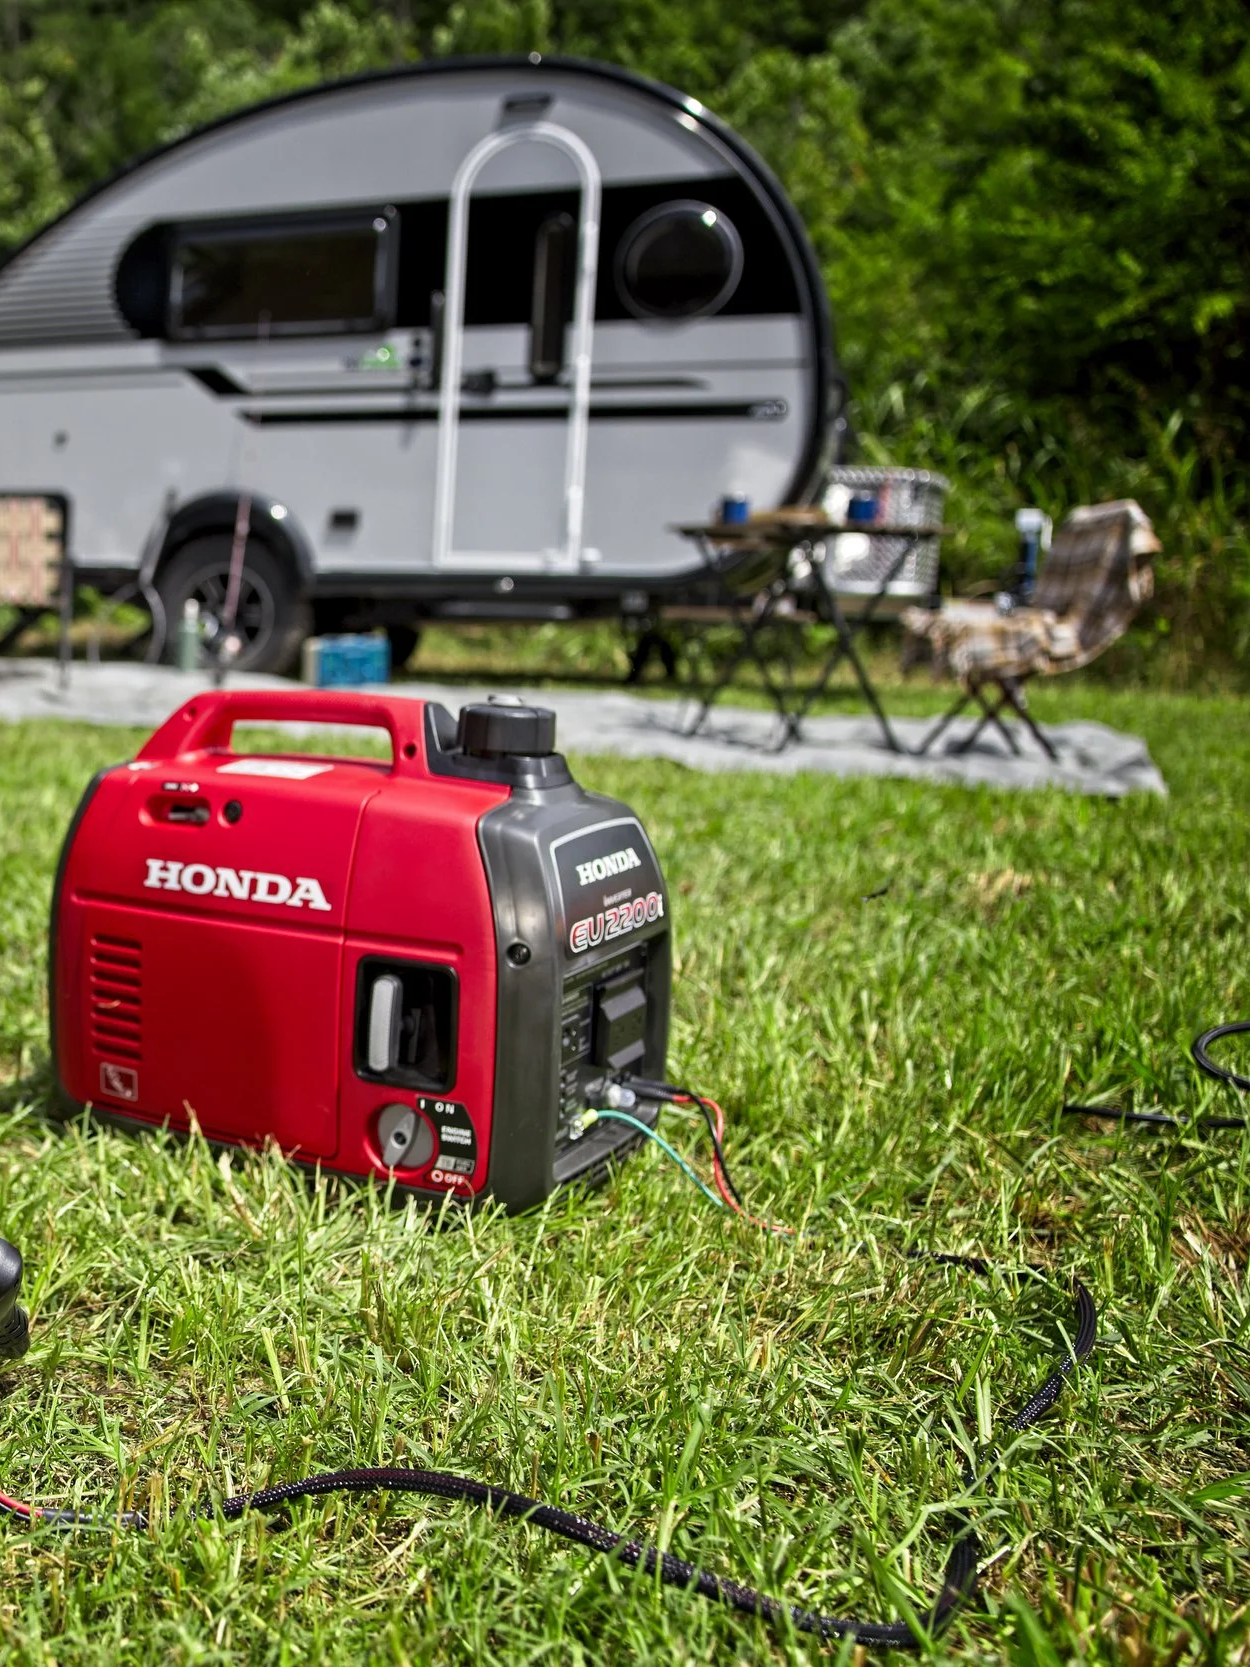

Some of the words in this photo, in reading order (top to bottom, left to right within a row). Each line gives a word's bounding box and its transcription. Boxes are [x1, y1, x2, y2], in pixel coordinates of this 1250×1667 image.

[143, 858, 332, 911] HONDA
[576, 847, 641, 886] HONDA
[570, 892, 664, 953] EU2200i
[435, 1102, 454, 1114] ON
[444, 1175, 464, 1185] OFF
